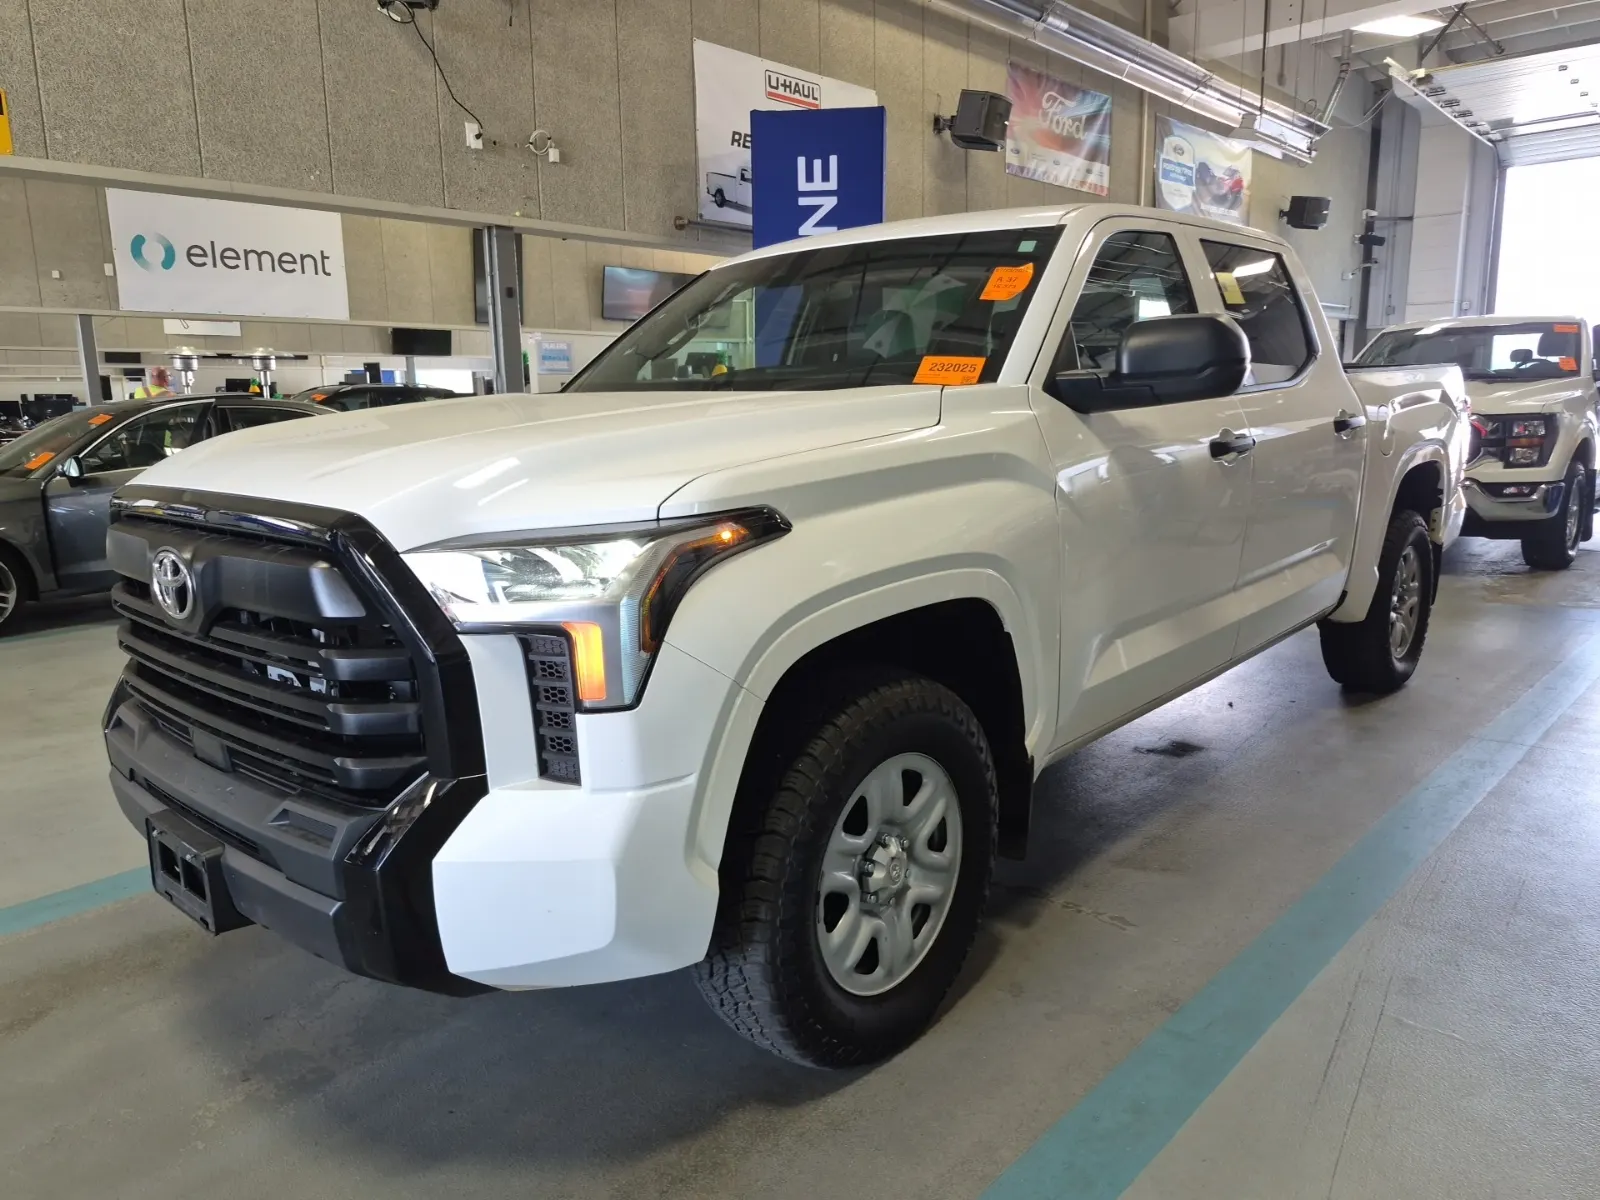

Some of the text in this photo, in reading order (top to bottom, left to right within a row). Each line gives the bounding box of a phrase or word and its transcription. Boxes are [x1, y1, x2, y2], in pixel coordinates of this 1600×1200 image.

[1039, 91, 1088, 141] Ford
[797, 154, 838, 236] NE
[186, 240, 332, 277] element
[928, 362, 978, 374] 232025
